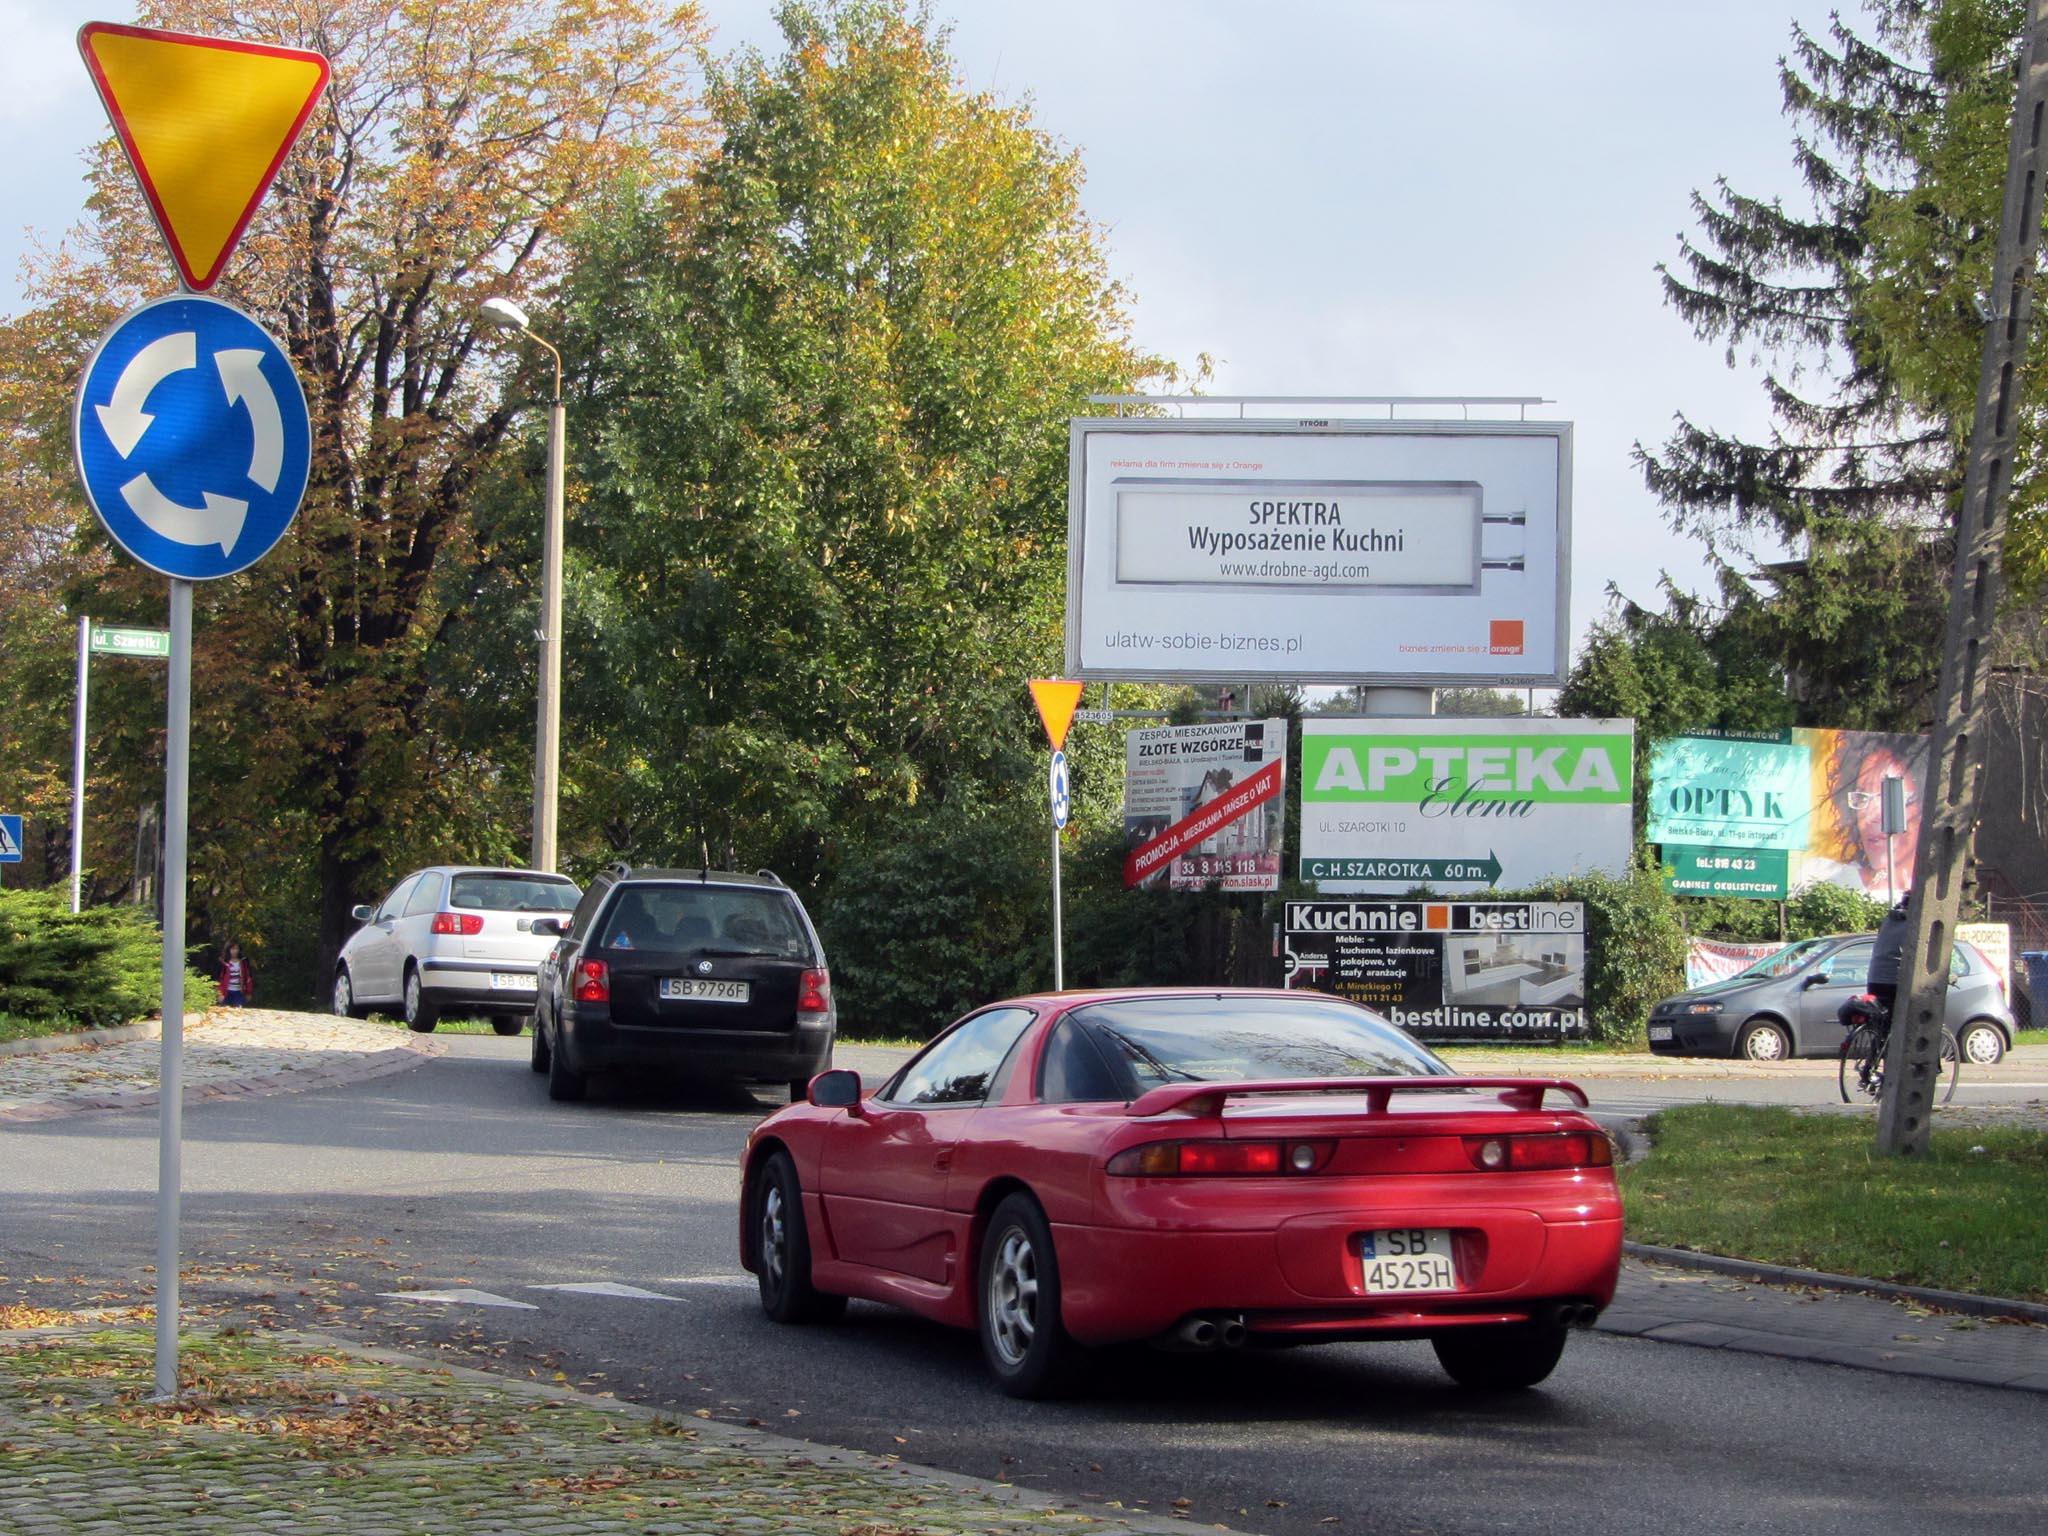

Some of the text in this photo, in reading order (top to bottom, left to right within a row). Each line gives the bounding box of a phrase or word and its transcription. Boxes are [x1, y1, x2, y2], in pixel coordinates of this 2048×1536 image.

[1110, 459, 1143, 468] reklama
[1145, 459, 1157, 469] dla
[1160, 459, 1176, 469] firm
[1178, 460, 1209, 469] zmienia
[1232, 461, 1263, 471] Orange
[1249, 501, 1342, 526] SPEKTRA
[1188, 526, 1404, 556] Wyposażenie Kuchni
[1220, 560, 1370, 581] www.drobne-agd.com
[95, 633, 160, 649] ul. Szarotki
[1105, 630, 1303, 654] ulatw-sobie-biznes.pl
[1400, 643, 1428, 653] biznes
[1430, 643, 1465, 653] zmienia
[1491, 646, 1520, 654] orange
[1139, 725, 1244, 741] ZESPÓŁ MIESZKANIOWY
[1139, 736, 1243, 757] ZŁOTE WZGÓRZE
[1313, 747, 1621, 792] APTEKA
[1418, 777, 1537, 819] Elena
[1669, 786, 1784, 819] OPTYK
[1135, 834, 1180, 872] PROMOCJA
[1183, 810, 1223, 842] MIESZKANIA
[1256, 775, 1272, 794] VAT
[1319, 821, 1406, 833] UL. SZAROTKI 10
[1181, 861, 1195, 875] 33
[1201, 860, 1209, 874] 8
[1235, 859, 1256, 873] 118
[1312, 862, 1487, 878] C.H.SZAROTKA 60 m.
[1672, 879, 1778, 892] GABINET OKULISTYCZNY
[1292, 904, 1575, 930] Kuchnie bestline
[1299, 952, 1328, 960] Andersa
[1340, 946, 1384, 956] kuchenne,
[1340, 957, 1397, 967] pokojowe, tv
[500, 975, 514, 986] SB
[1340, 968, 1407, 979] szafy aranżacje
[671, 980, 745, 998] SB 9796F
[1379, 1006, 1583, 1032] bestline.com.pl
[1387, 1230, 1427, 1257] SB
[1368, 1260, 1452, 1290] 4525H
